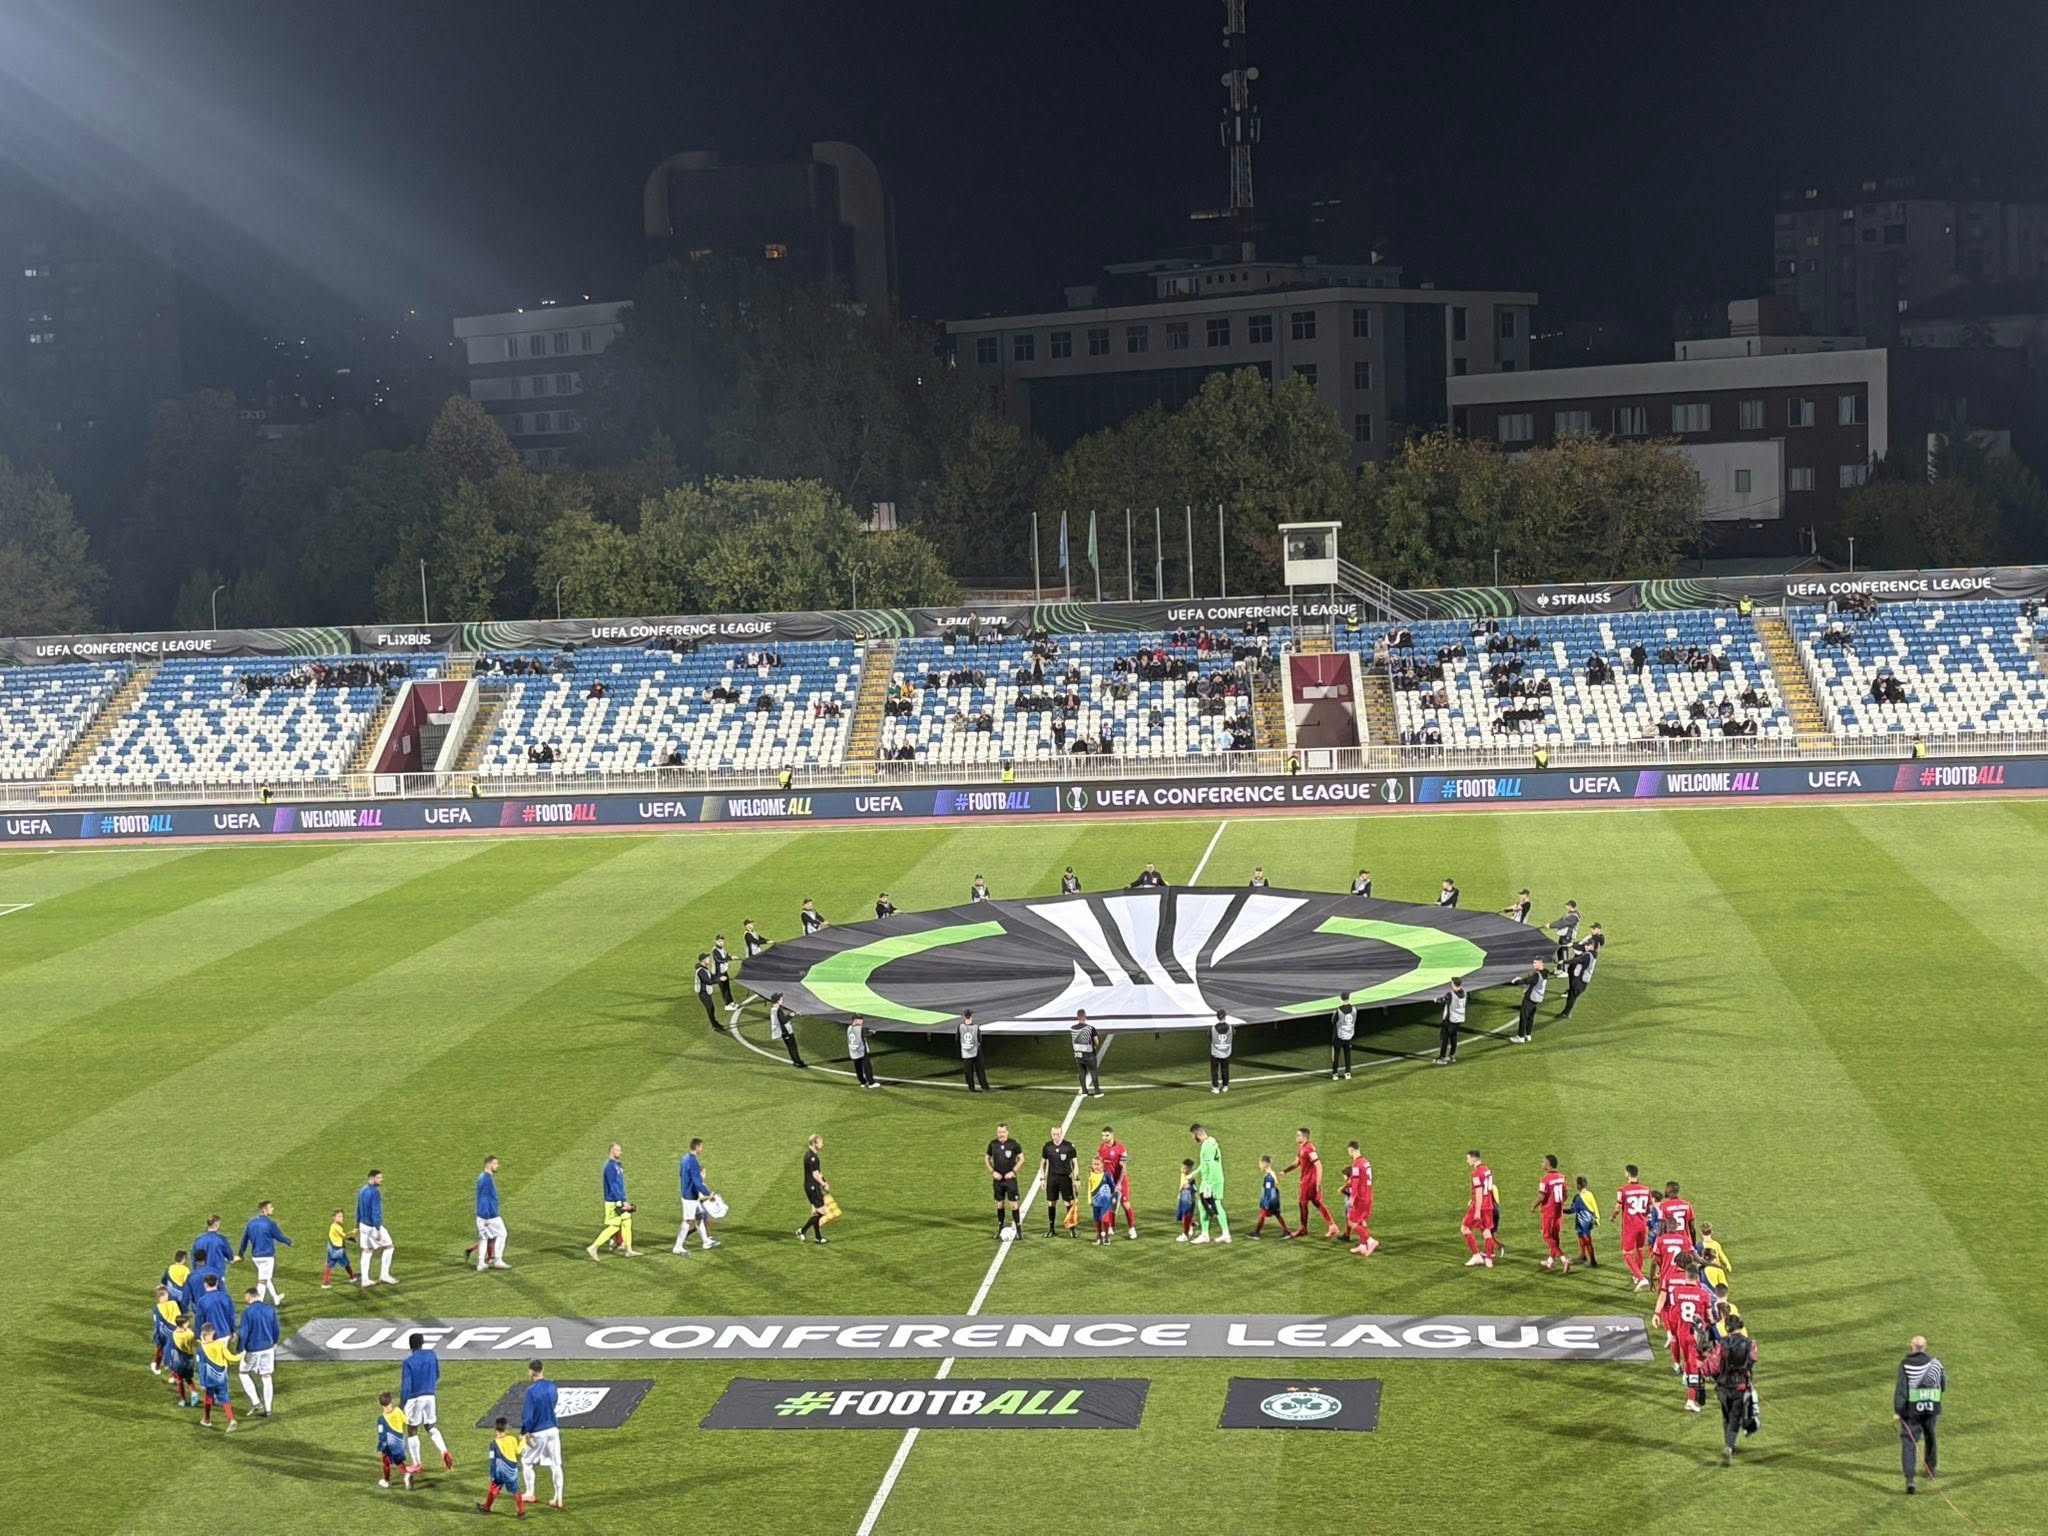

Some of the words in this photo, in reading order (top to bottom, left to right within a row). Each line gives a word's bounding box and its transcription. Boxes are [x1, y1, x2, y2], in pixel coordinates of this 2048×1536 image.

[1786, 586, 1827, 596] UEFA
[1829, 580, 1928, 595] CONFERENCE
[1932, 577, 1992, 590] LEAGUE
[1551, 592, 1611, 606] STRAUSS
[1168, 608, 1205, 622] UEFA
[1207, 605, 1299, 620] CONFERENCE
[1302, 603, 1357, 617] LEAGUE
[591, 627, 627, 639] UEFA
[629, 624, 717, 638] CONFERENCE
[719, 621, 773, 635] LEAGUE
[36, 643, 71, 657] UEFA
[73, 639, 160, 655] CONFERENCE
[161, 639, 213, 652] LEAGUE
[1569, 777, 1621, 793] UEFA
[1808, 771, 1862, 788] UEFA
[1920, 765, 2004, 786] #FOOTBALL
[1096, 789, 1149, 806] UEFA
[1154, 786, 1286, 804] CONFERENCE
[1441, 778, 1522, 798] #FOOTBALL
[639, 802, 687, 818] UEFA
[855, 796, 904, 812] UEFA
[955, 791, 1032, 811] #FOOTBALL
[214, 813, 260, 829] UEFA
[424, 808, 473, 824] UEFA
[522, 804, 597, 822] #FOOTBALL
[6, 819, 52, 835] UEFA
[100, 814, 173, 833] #FOOTBALL
[1626, 1195, 1648, 1216] 30
[1673, 1210, 1686, 1231] 5
[1680, 1301, 1696, 1323] 8
[324, 1326, 555, 1350] UEFA
[583, 1324, 1191, 1349] CONFERENCE
[1226, 1324, 1600, 1350] LEAGUE
[774, 1389, 1088, 1417] #FOOTBALL
